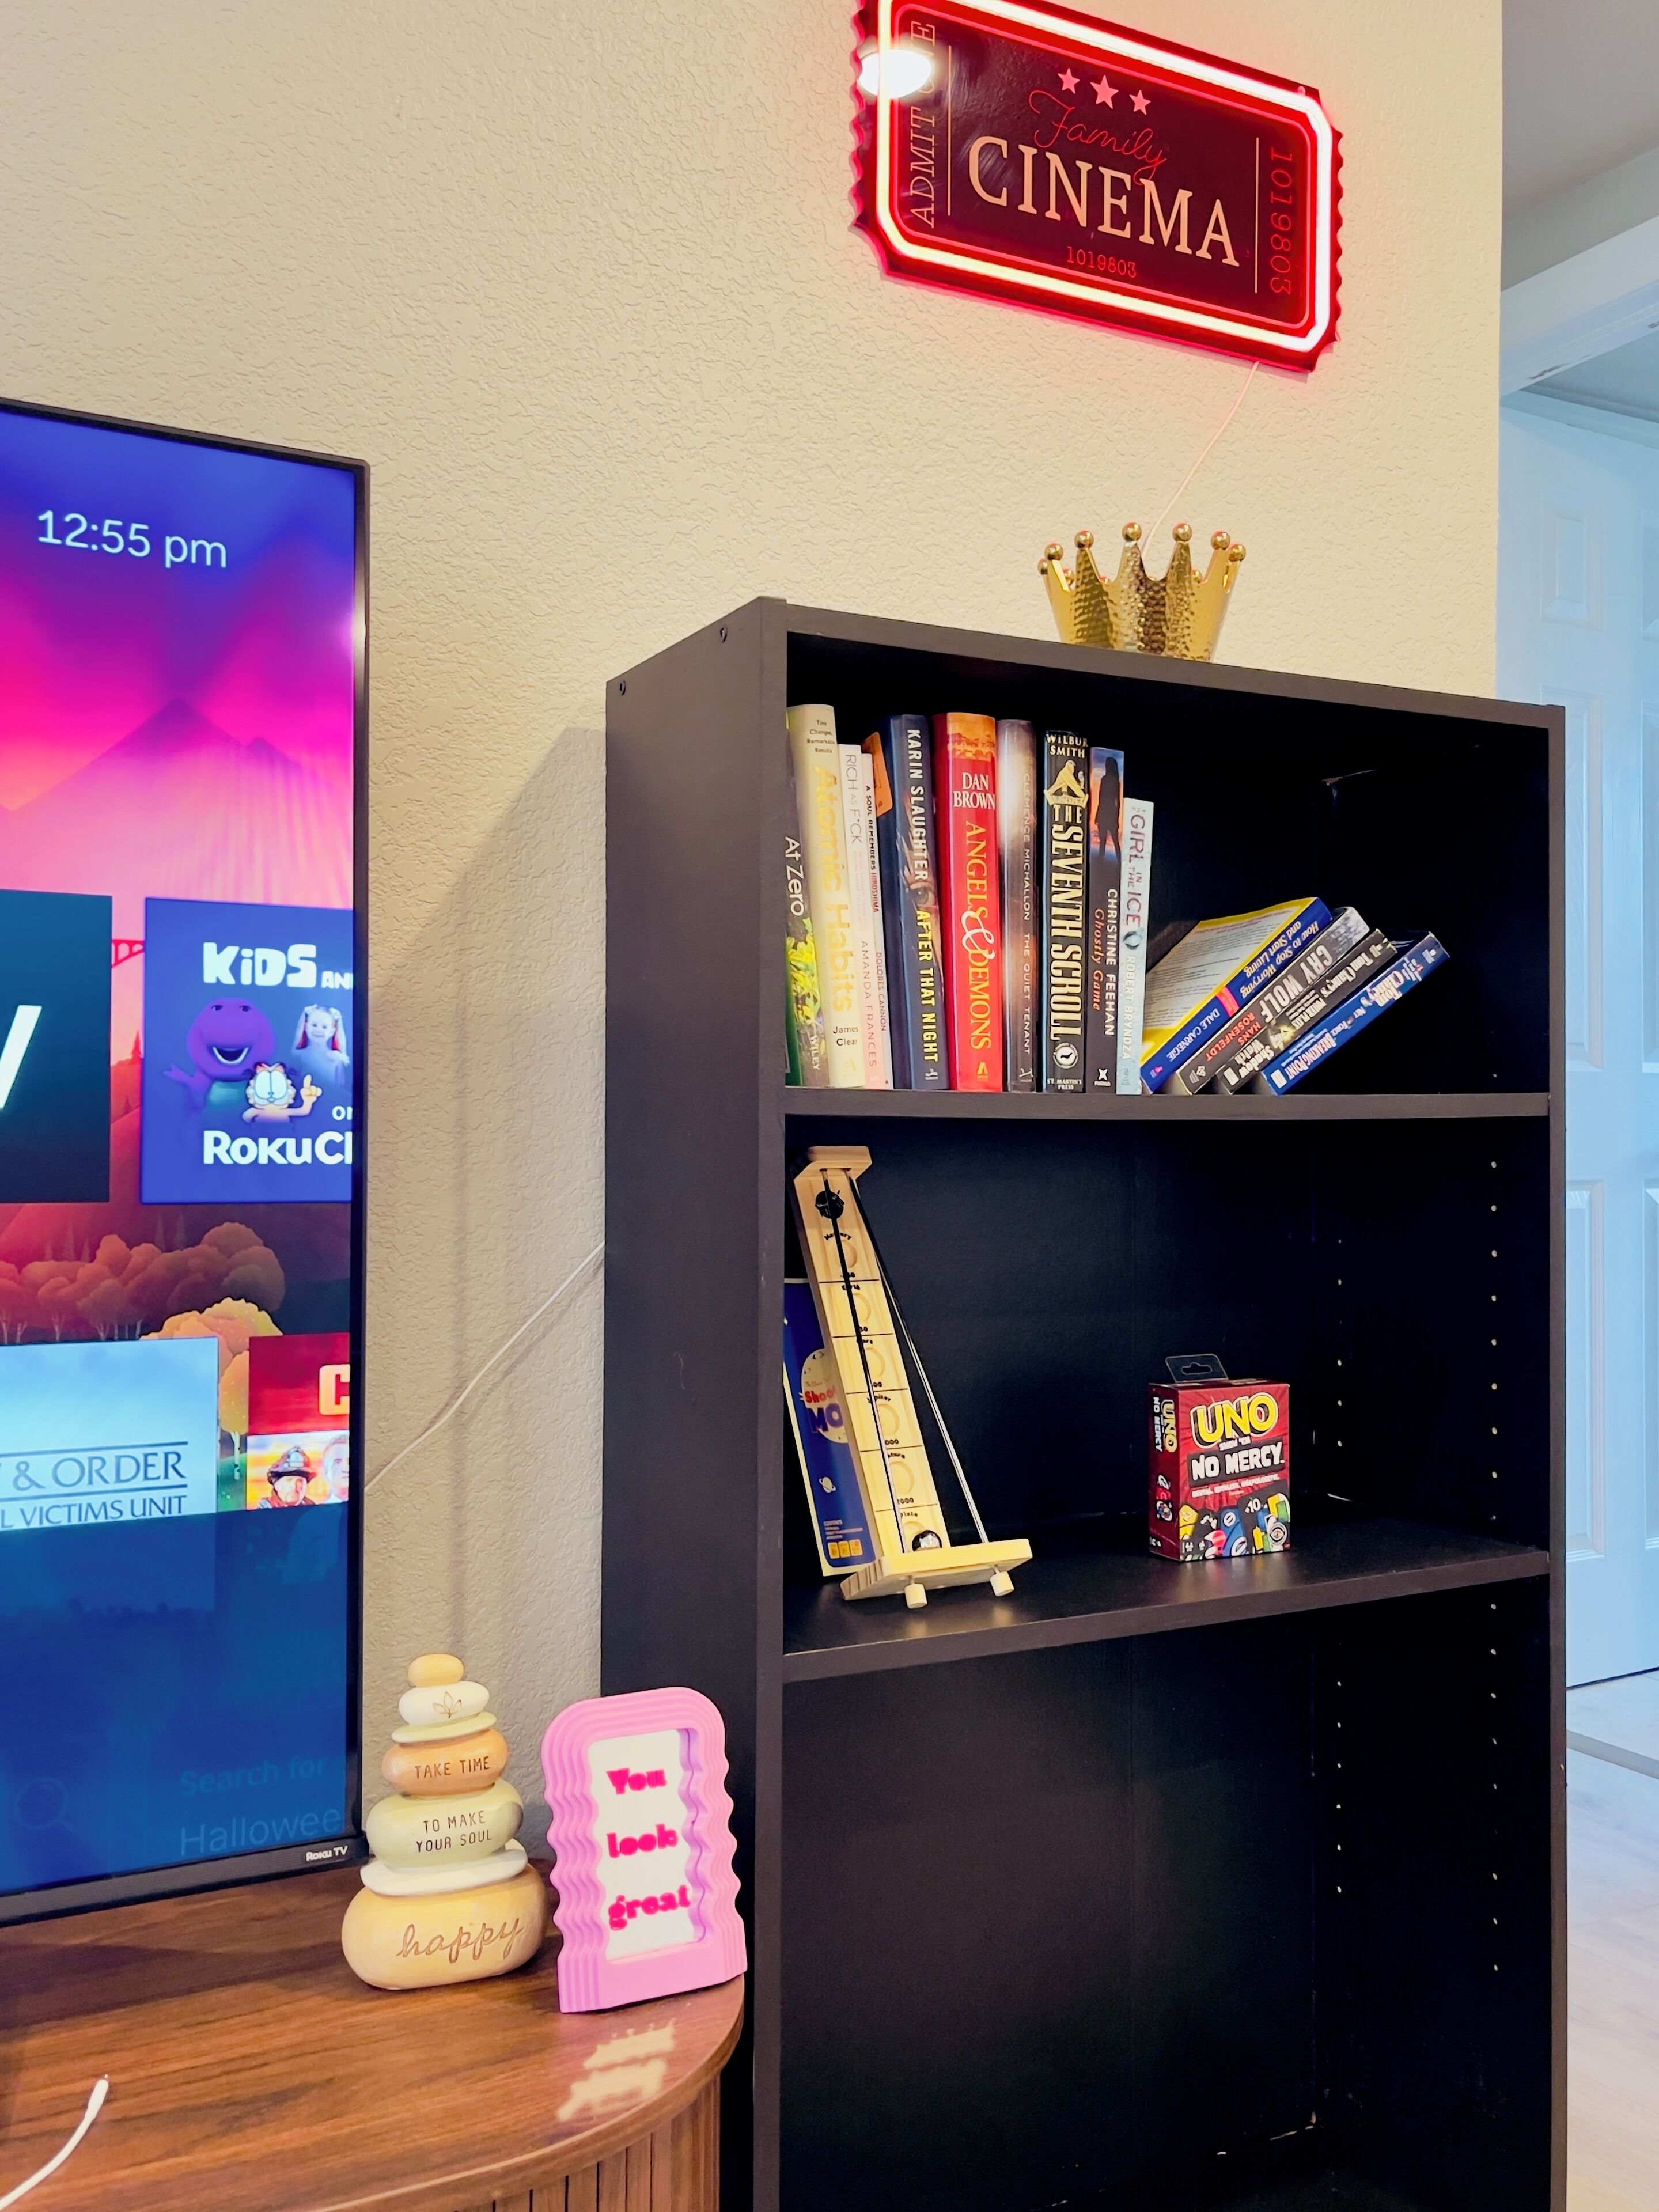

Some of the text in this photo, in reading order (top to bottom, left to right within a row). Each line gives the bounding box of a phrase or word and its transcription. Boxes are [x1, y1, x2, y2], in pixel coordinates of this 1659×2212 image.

[1028, 90, 1167, 184] Family
[910, 107, 936, 228] ADMIT
[968, 135, 1240, 267] CINEMA
[1270, 149, 1293, 296] 1019803
[1066, 246, 1137, 278] 1019803
[37, 510, 227, 569] 12:55 pm
[1046, 733, 1088, 748] WILBUR
[1050, 746, 1085, 759] SMITH
[845, 754, 859, 790] RICH
[961, 772, 989, 790] DAN
[907, 729, 929, 880] KARIN SLAUGHTER
[953, 790, 996, 810] BROWN
[1053, 804, 1083, 824] THE
[868, 820, 876, 870] REMEMBERS
[1128, 814, 1146, 863] GIRL
[785, 836, 805, 916] At Zero
[811, 765, 855, 1013] Atomic Habits
[965, 821, 988, 919] ANGELS
[1051, 824, 1084, 938] SEVENTH
[1135, 872, 1142, 883] IN
[1126, 891, 1143, 928] ICE
[961, 910, 995, 960] &
[1243, 921, 1301, 978] and Start Living
[1293, 937, 1302, 949] to
[1301, 921, 1319, 940] How
[876, 952, 884, 990] DOLORES
[1090, 908, 1105, 1011] Ghostly Game
[1104, 889, 1118, 1036] CHRISTINE FEEHAN
[1275, 949, 1293, 965] Stop
[1300, 945, 1333, 984] CRY
[1350, 952, 1374, 970] Tom
[916, 910, 938, 1062] AFTER THAT NIGHT
[968, 948, 991, 1050] DEMONS
[1050, 944, 1082, 1041] SCROLL
[1125, 955, 1135, 1004] ROBERT
[1239, 963, 1277, 999] Worrying
[1259, 974, 1304, 1024] WOLF
[861, 940, 877, 1067] AMANDA FRANCES
[833, 1025, 859, 1034] James
[836, 1038, 858, 1046] Clear
[1121, 1005, 1134, 1060] BRYNDZA
[1166, 1008, 1221, 1062] DALE CARNEGIE
[1205, 1012, 1256, 1062] ROSENFELDT
[1237, 1022, 1262, 1046] HANS
[809, 1035, 820, 1070] WILEY
[1234, 1039, 1266, 1066] Watch
[1238, 1045, 1275, 1080] Shadow
[1153, 1396, 1160, 1414] NO
[1191, 1393, 1278, 1448] UNO
[1153, 1415, 1163, 1453] MERCY
[1161, 1399, 1178, 1453] UNO
[12, 1451, 188, 1491] & ORDER
[1191, 1455, 1220, 1481] NO
[20, 1499, 124, 1528] VICTIMS
[130, 1495, 187, 1517] UNIT
[180, 1755, 327, 1797] Search for
[414, 1756, 491, 1780] TAKE TIME
[606, 1767, 667, 1795] You
[416, 1829, 493, 1853] YOUR SOUL
[423, 1812, 486, 1834] TO MAKE
[607, 1823, 679, 1858] look
[305, 1845, 348, 1862] Roku TV
[608, 1884, 691, 1930] great
[396, 1916, 525, 1964] happy
